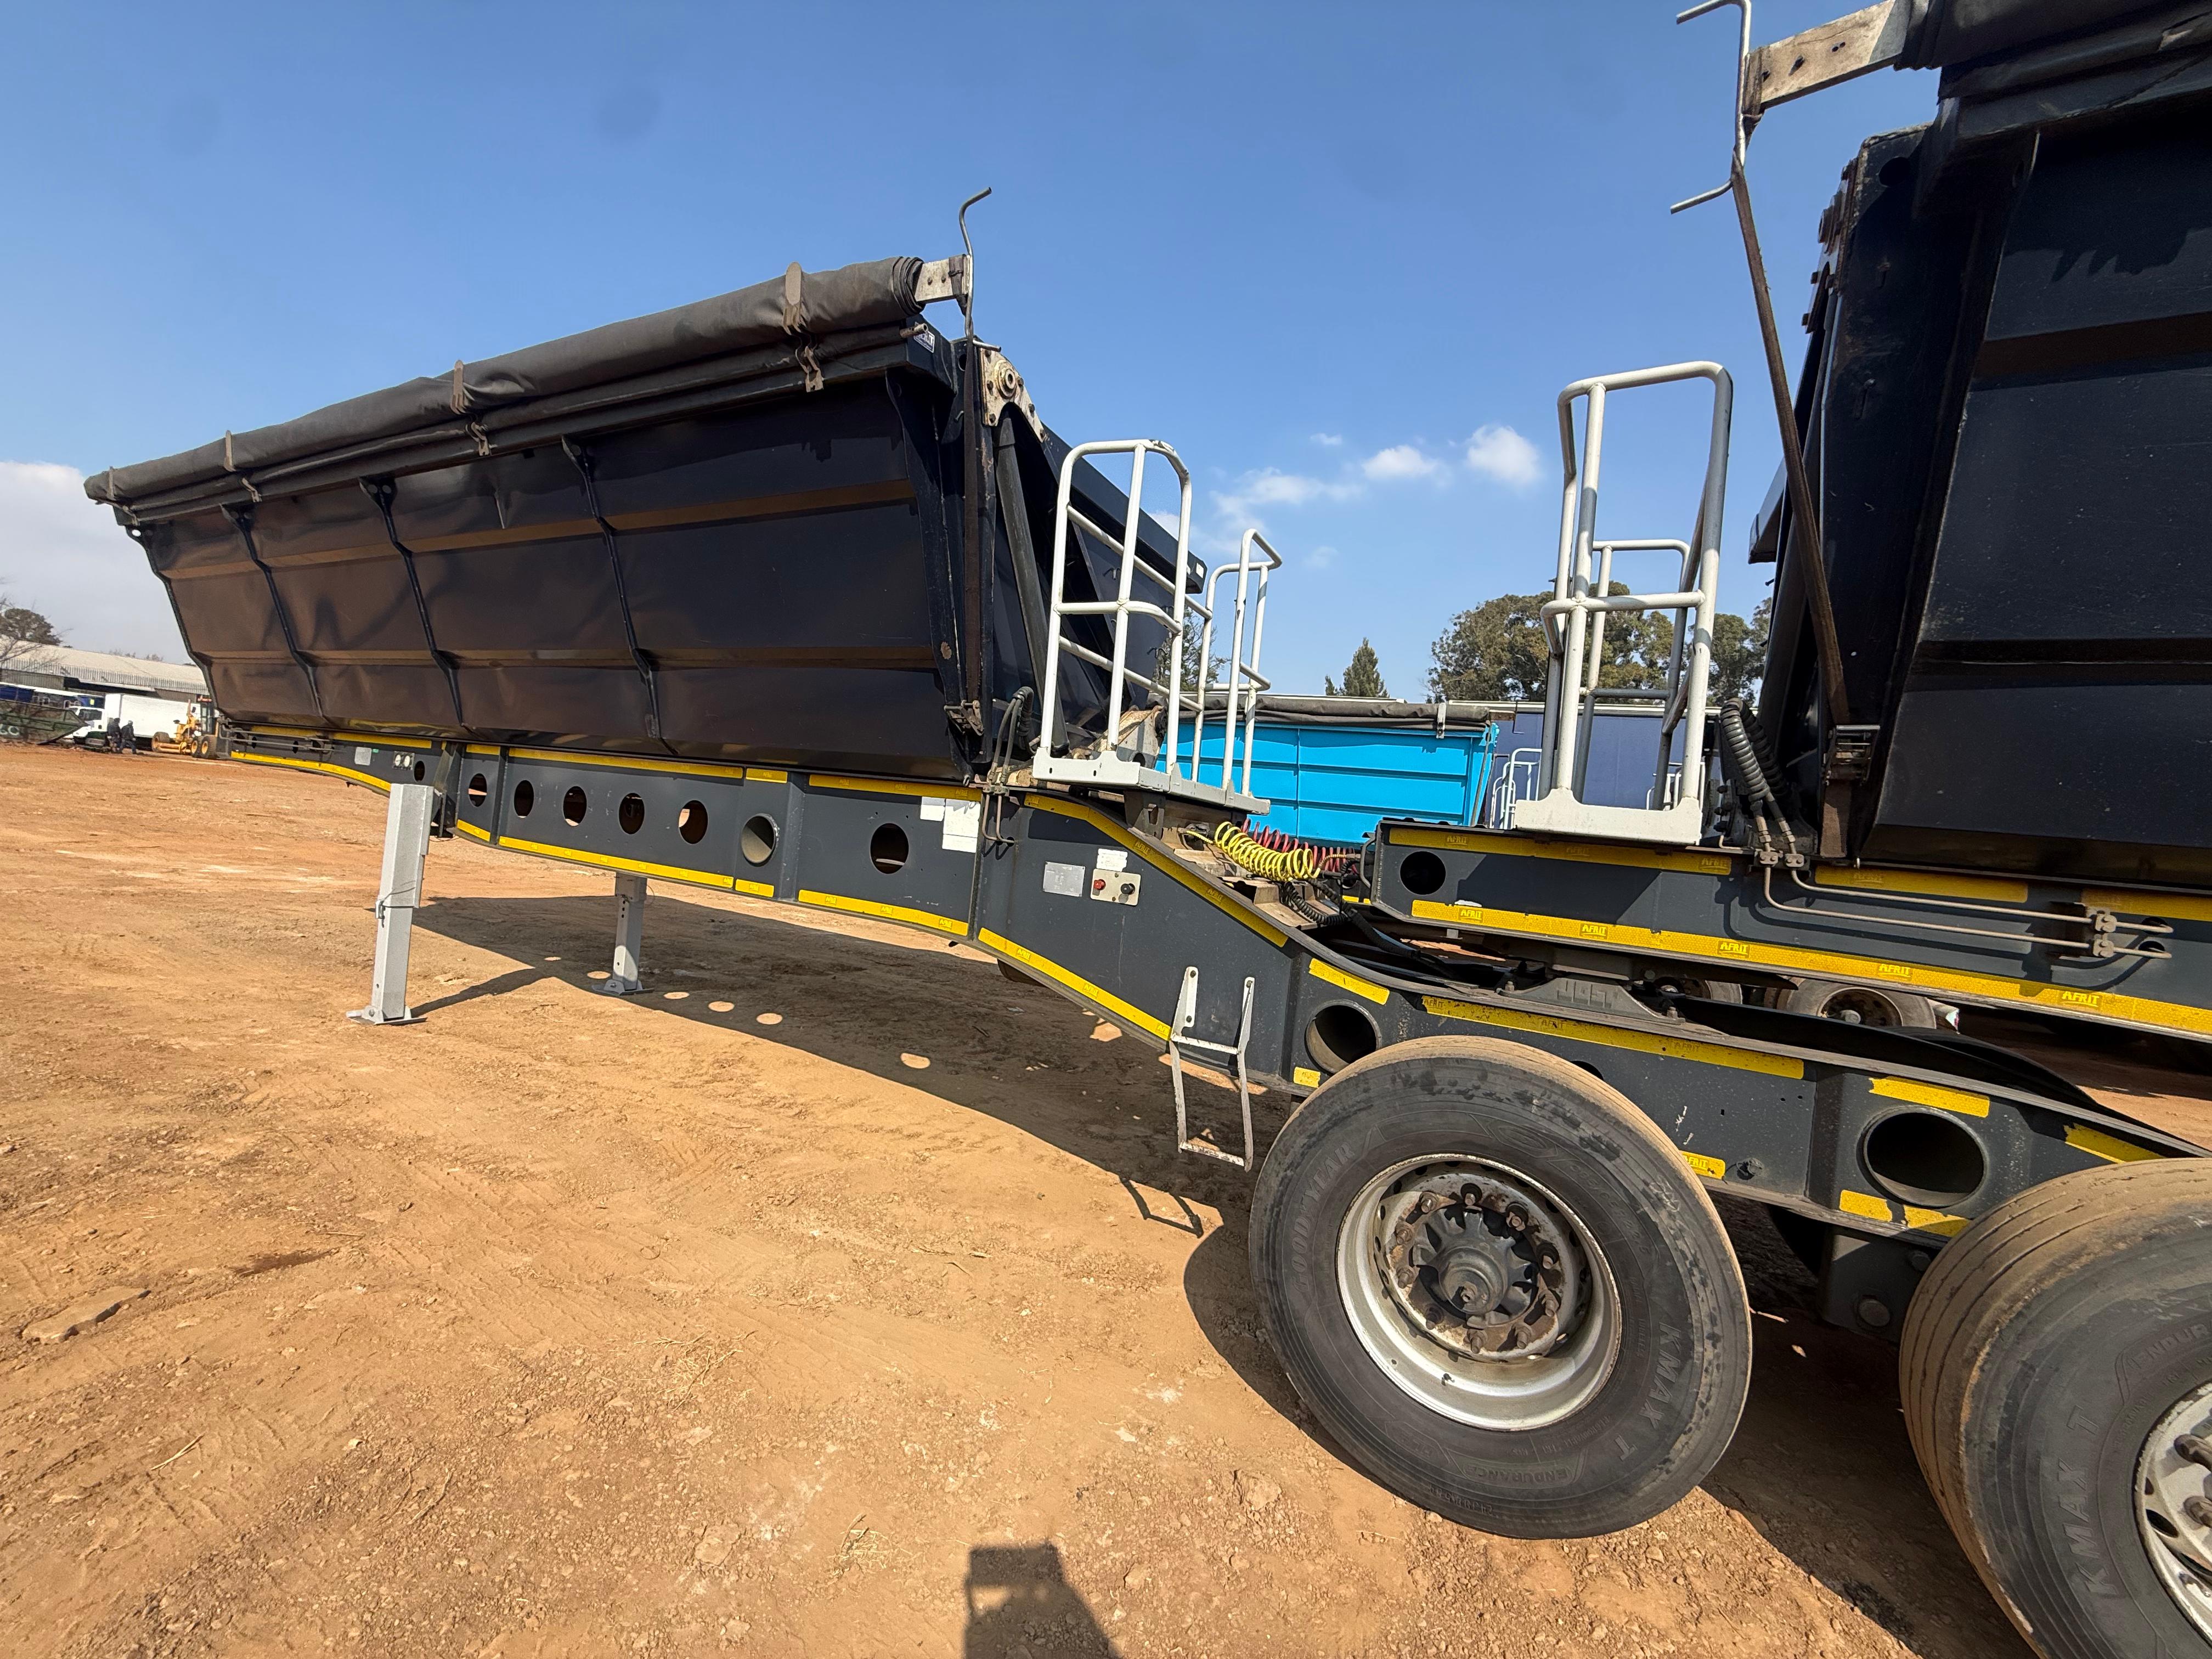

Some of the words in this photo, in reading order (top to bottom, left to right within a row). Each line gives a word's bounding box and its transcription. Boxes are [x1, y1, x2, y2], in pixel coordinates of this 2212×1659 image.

[1460, 909, 1482, 918] AFRIT
[1582, 924, 1607, 934] AFRIT
[1720, 942, 1748, 952] AFRIT
[1878, 964, 1911, 975] AFRIT
[1424, 998, 1444, 1008] AFRIT
[2062, 991, 2100, 1005] AFRIT
[1291, 1141, 1355, 1293] GOODYEAR
[1638, 1322, 1682, 1430] KMAX
[1615, 1435, 1638, 1462] T
[1466, 1464, 1571, 1483] ENDURANCE
[2058, 1457, 2118, 1595] KMAX
